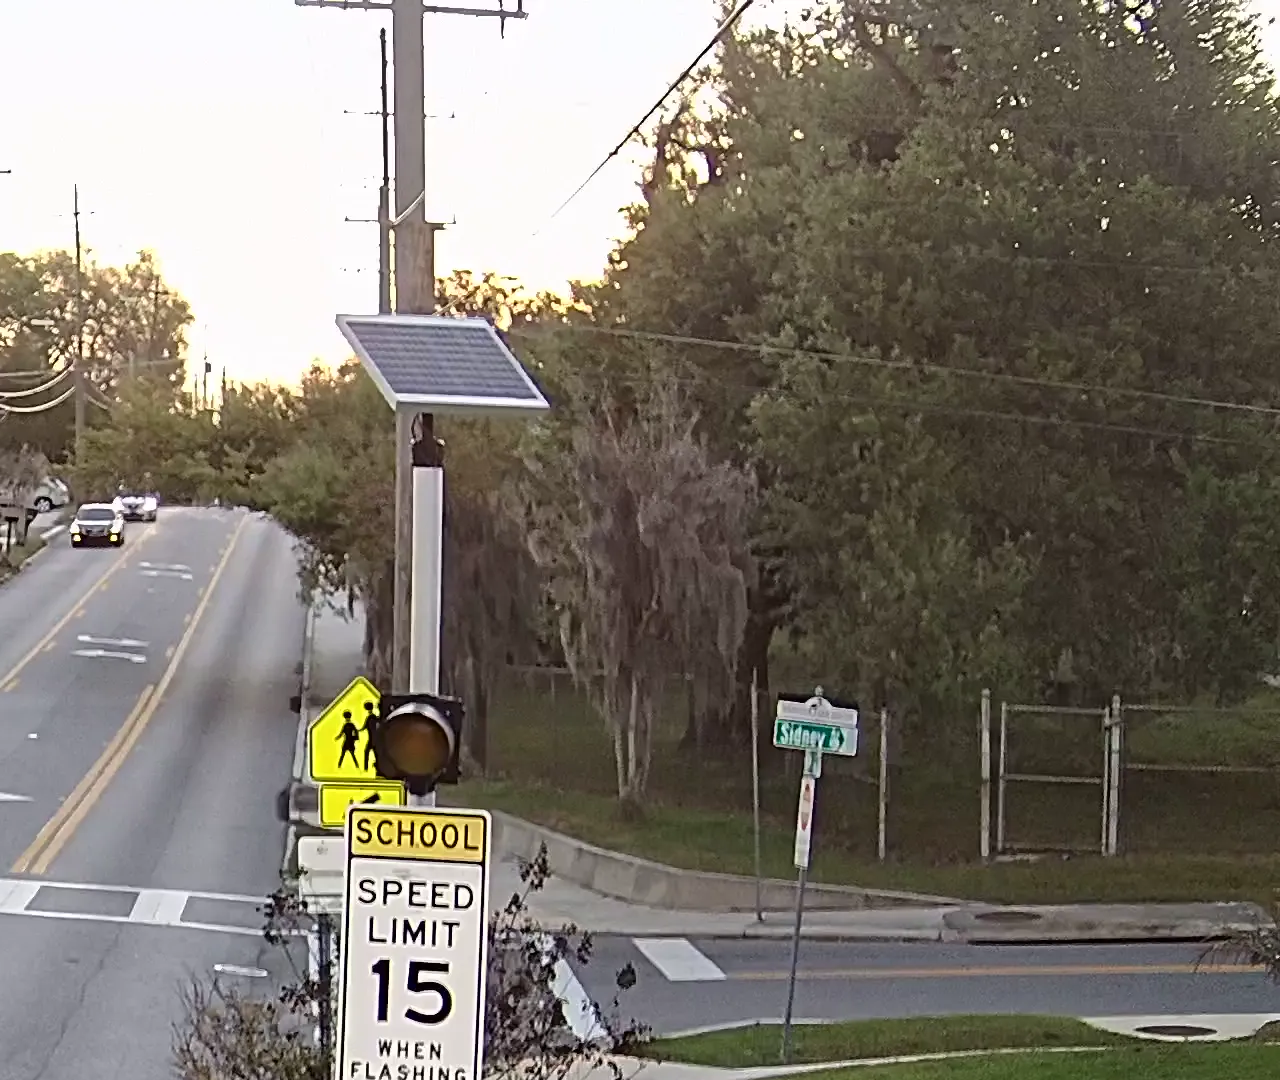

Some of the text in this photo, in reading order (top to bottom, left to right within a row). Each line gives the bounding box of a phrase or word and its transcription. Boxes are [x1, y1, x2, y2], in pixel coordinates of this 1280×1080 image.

[355, 818, 480, 850] SCHOOL
[358, 879, 474, 910] SPEED
[368, 916, 460, 947] LIMIT
[371, 959, 453, 1024] 15
[378, 1039, 442, 1060] WHEN
